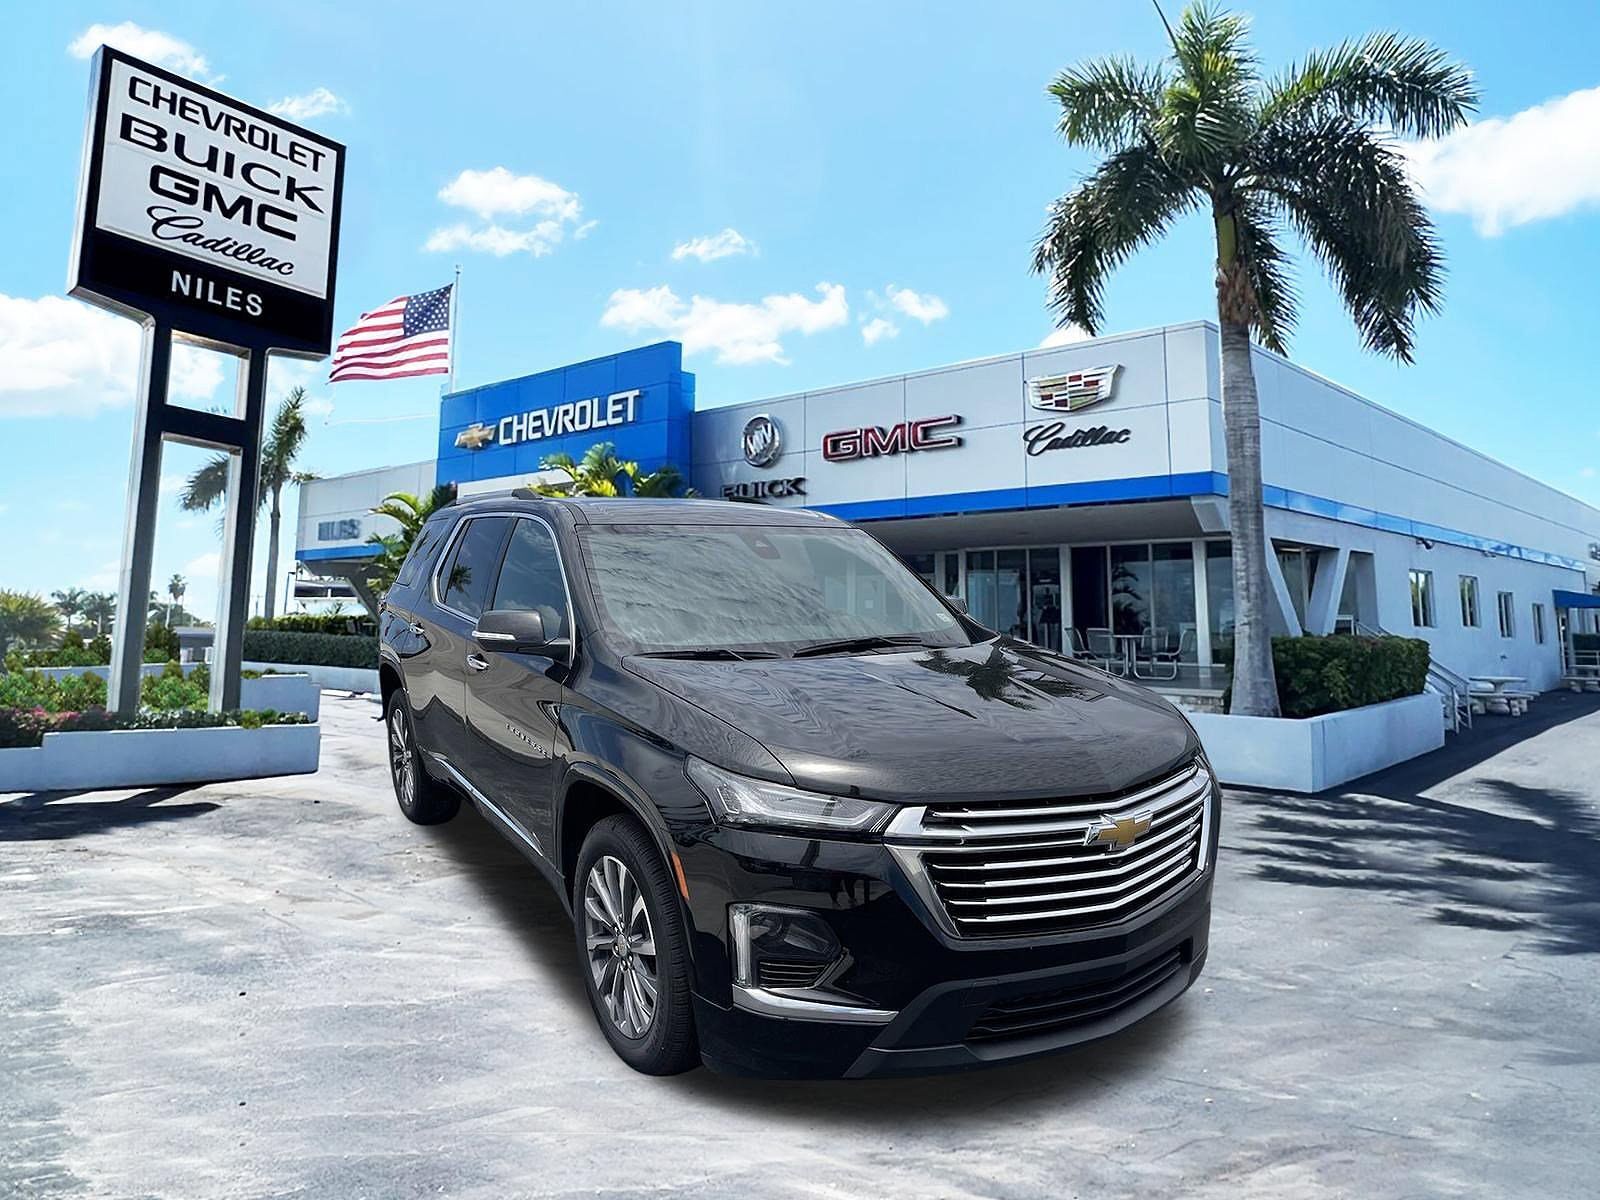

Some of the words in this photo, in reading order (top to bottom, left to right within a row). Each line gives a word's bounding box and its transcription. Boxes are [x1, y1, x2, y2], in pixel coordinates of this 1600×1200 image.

[128, 75, 326, 173] CHEVROLET
[119, 112, 325, 214] BUICK
[149, 164, 298, 241] GMC
[146, 205, 294, 275] Cadillac
[170, 271, 263, 316] NILES
[498, 389, 640, 446] CHEVROLET
[822, 413, 963, 462] GMC
[1022, 421, 1132, 457] Cadillac
[721, 476, 808, 498] BUICK
